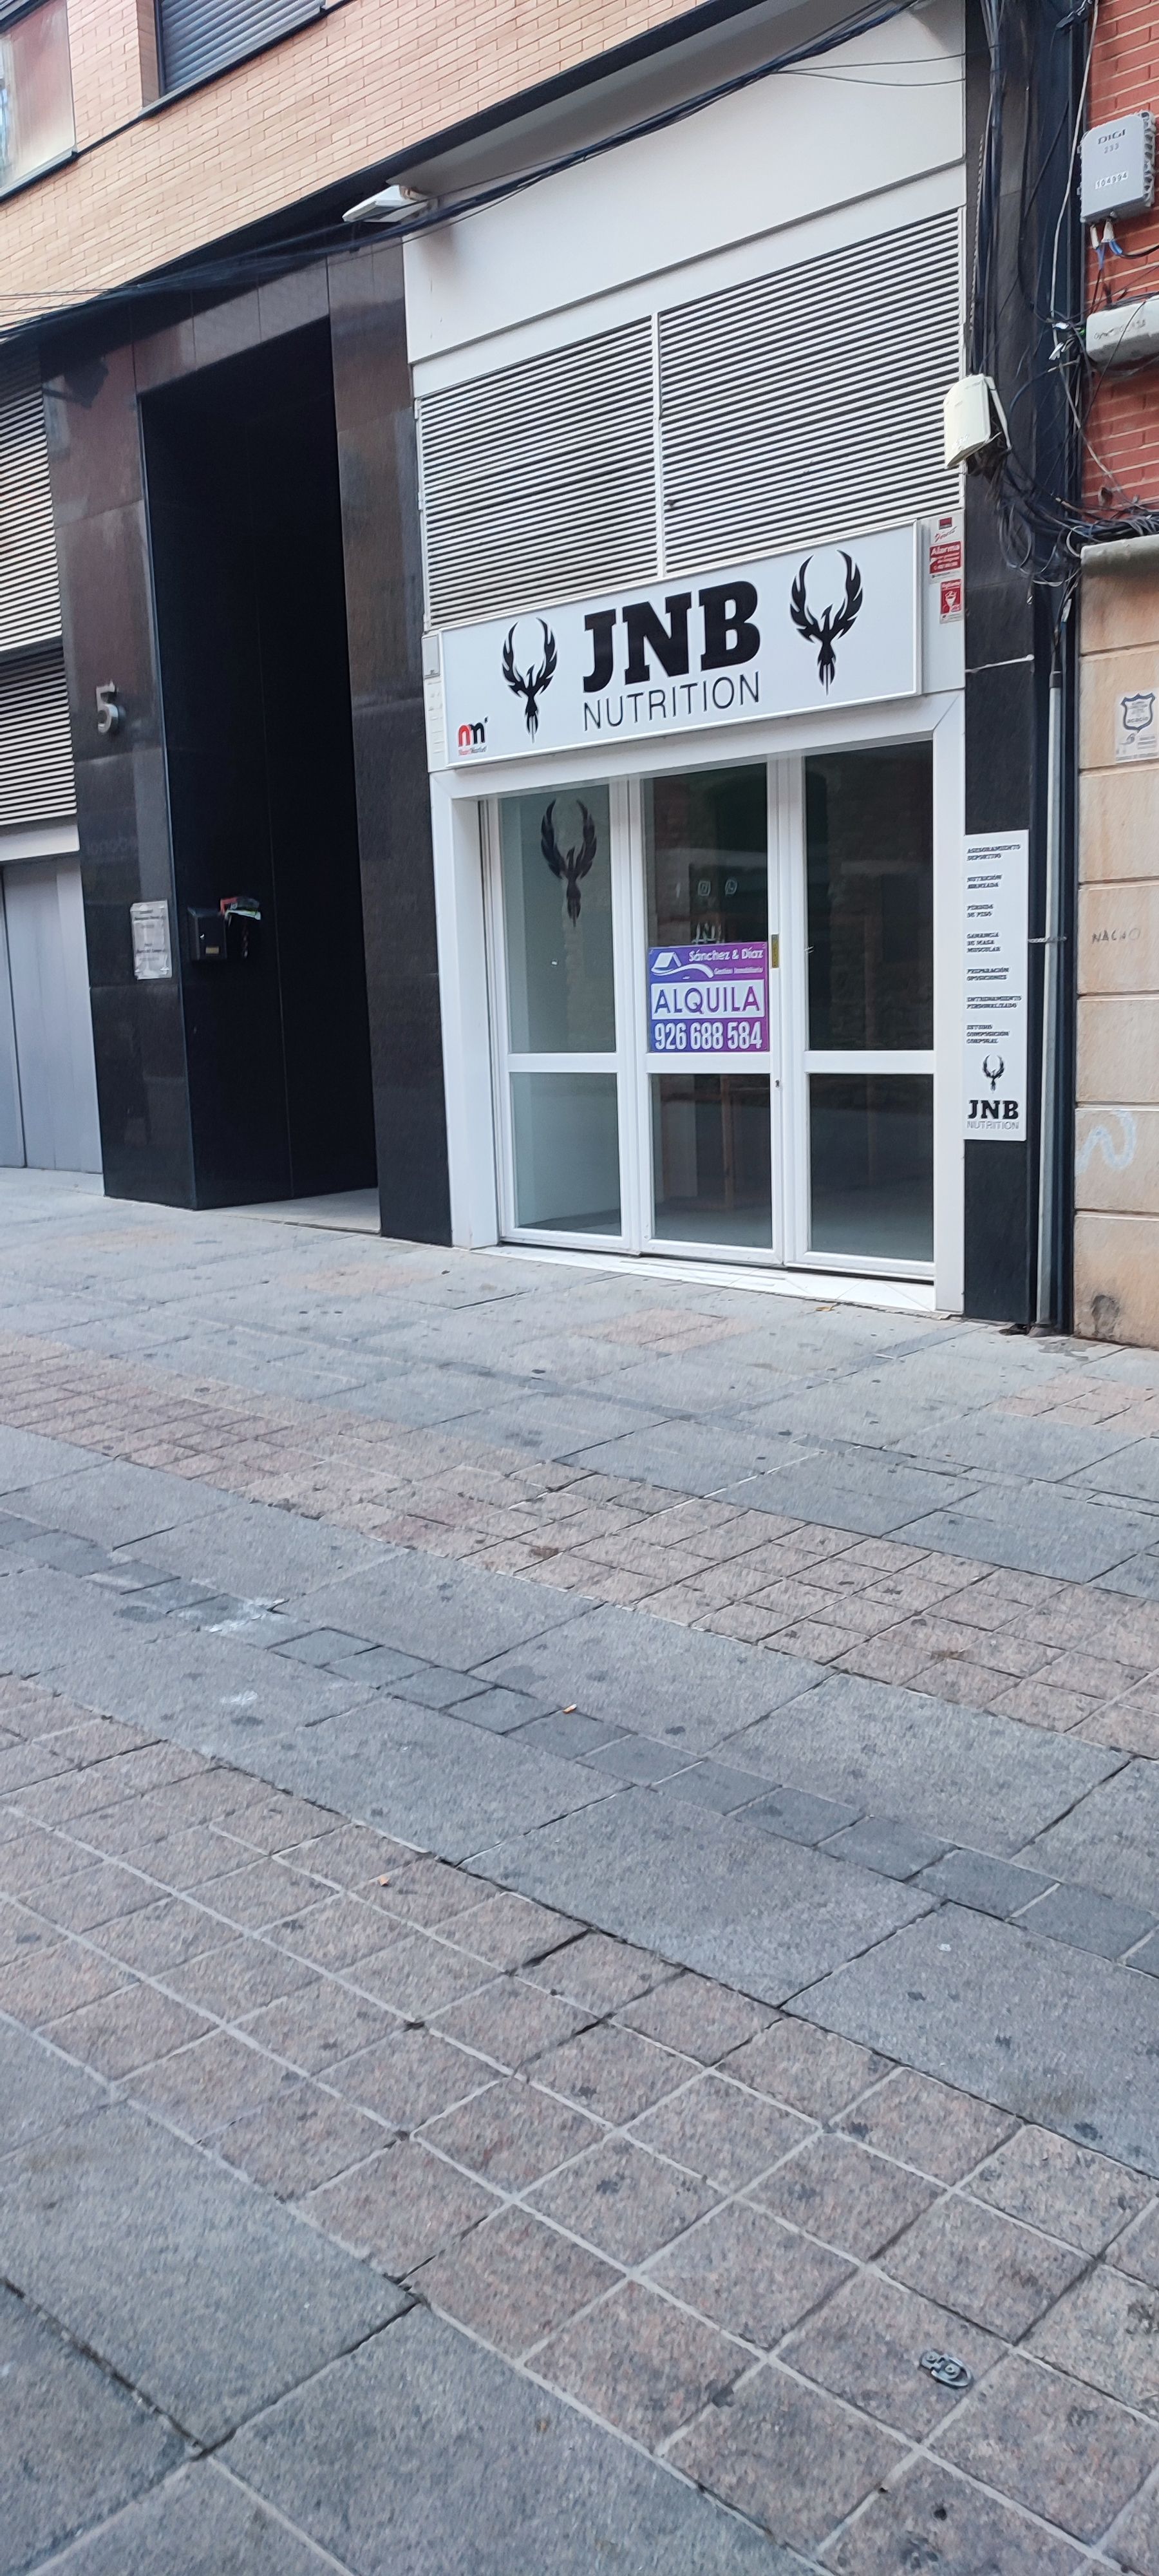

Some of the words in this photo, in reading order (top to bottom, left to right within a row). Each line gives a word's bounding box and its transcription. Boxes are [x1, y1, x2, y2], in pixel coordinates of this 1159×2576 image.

[1098, 129, 1126, 144] DIGI
[1096, 172, 1127, 187] 104994
[583, 581, 760, 692] JNB
[96, 679, 118, 733] 5
[585, 671, 759, 731] NUTRITION
[689, 949, 730, 961] Sánchez
[732, 949, 739, 960] &
[742, 946, 764, 960] Díaz
[654, 986, 760, 1014] ALQUILA
[654, 1022, 687, 1050] 926
[690, 1021, 724, 1050] 688
[727, 1021, 762, 1049] 584
[968, 1100, 1019, 1119] JNB
[967, 1121, 1020, 1130] NUTRITION
